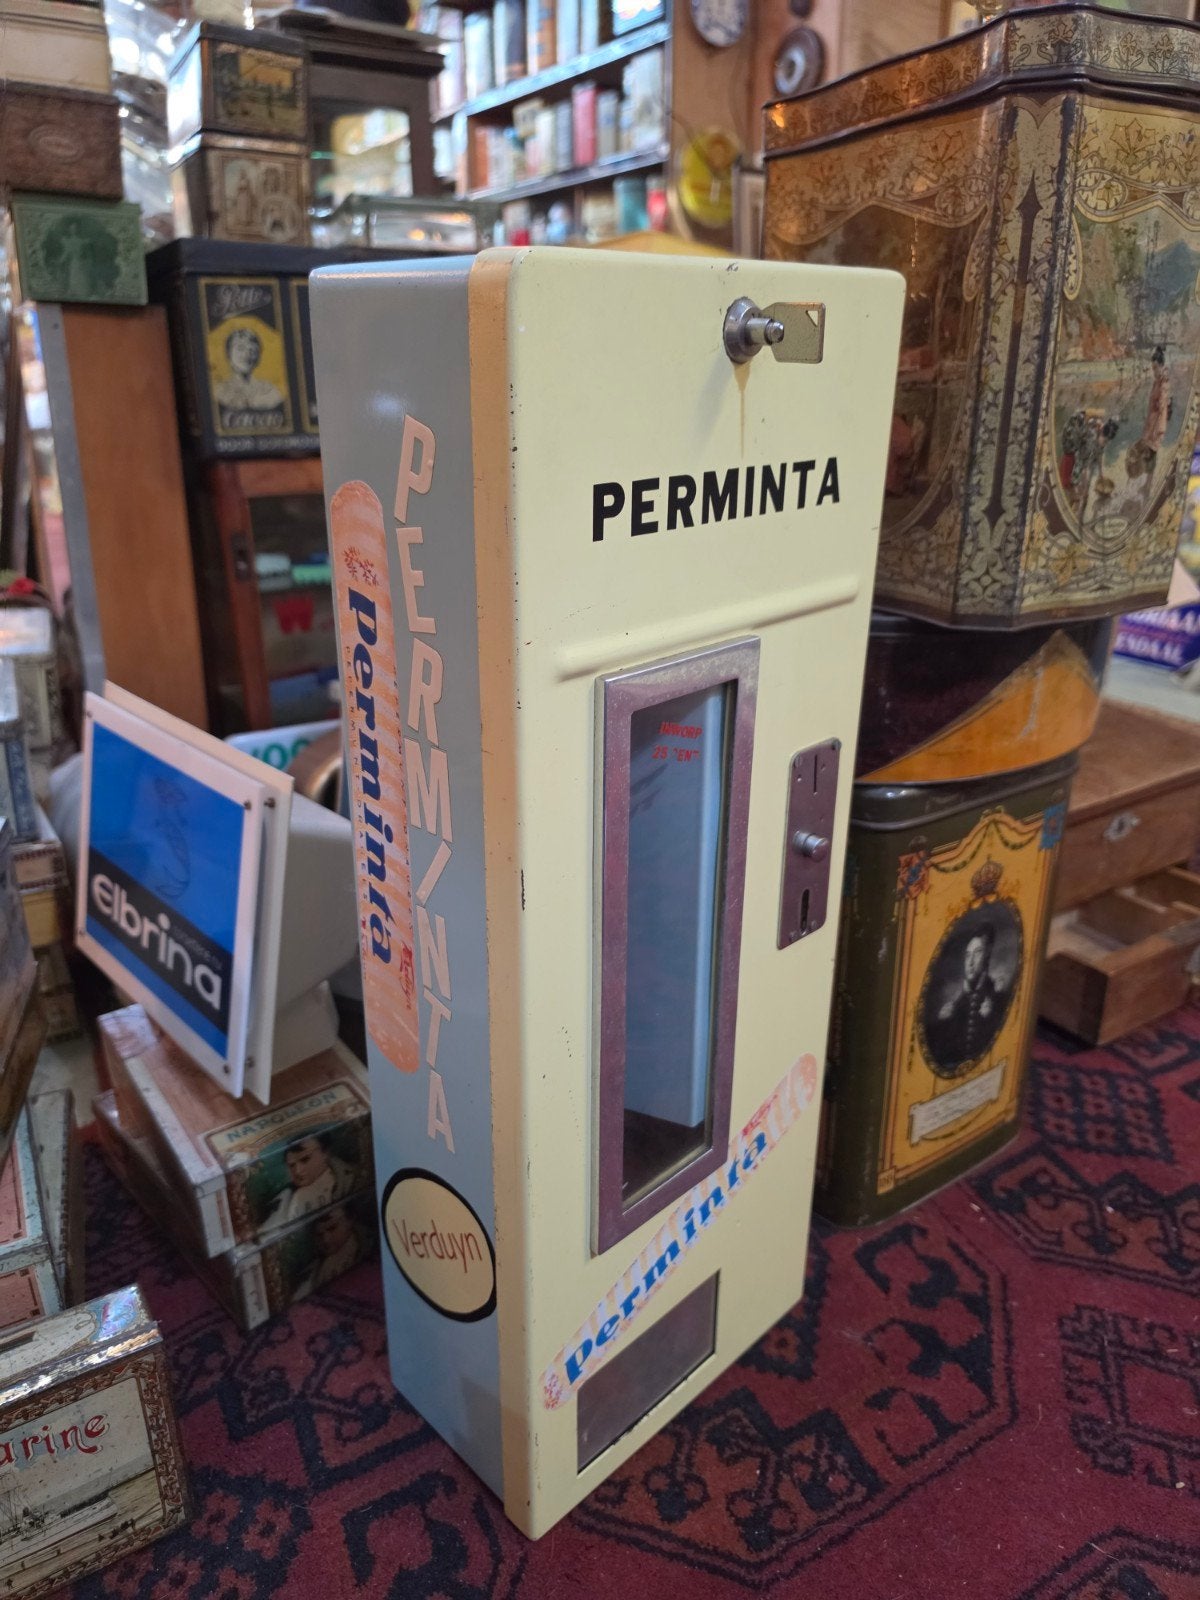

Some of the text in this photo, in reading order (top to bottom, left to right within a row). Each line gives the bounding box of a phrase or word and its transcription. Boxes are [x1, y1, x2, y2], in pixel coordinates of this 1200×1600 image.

[592, 457, 840, 542] PERMINTA
[348, 586, 398, 965] Perminta
[394, 414, 455, 1154] PERMINTA
[91, 873, 222, 1011] elbrina
[393, 1219, 482, 1274] Verduyn
[565, 1131, 767, 1386] Perminta
